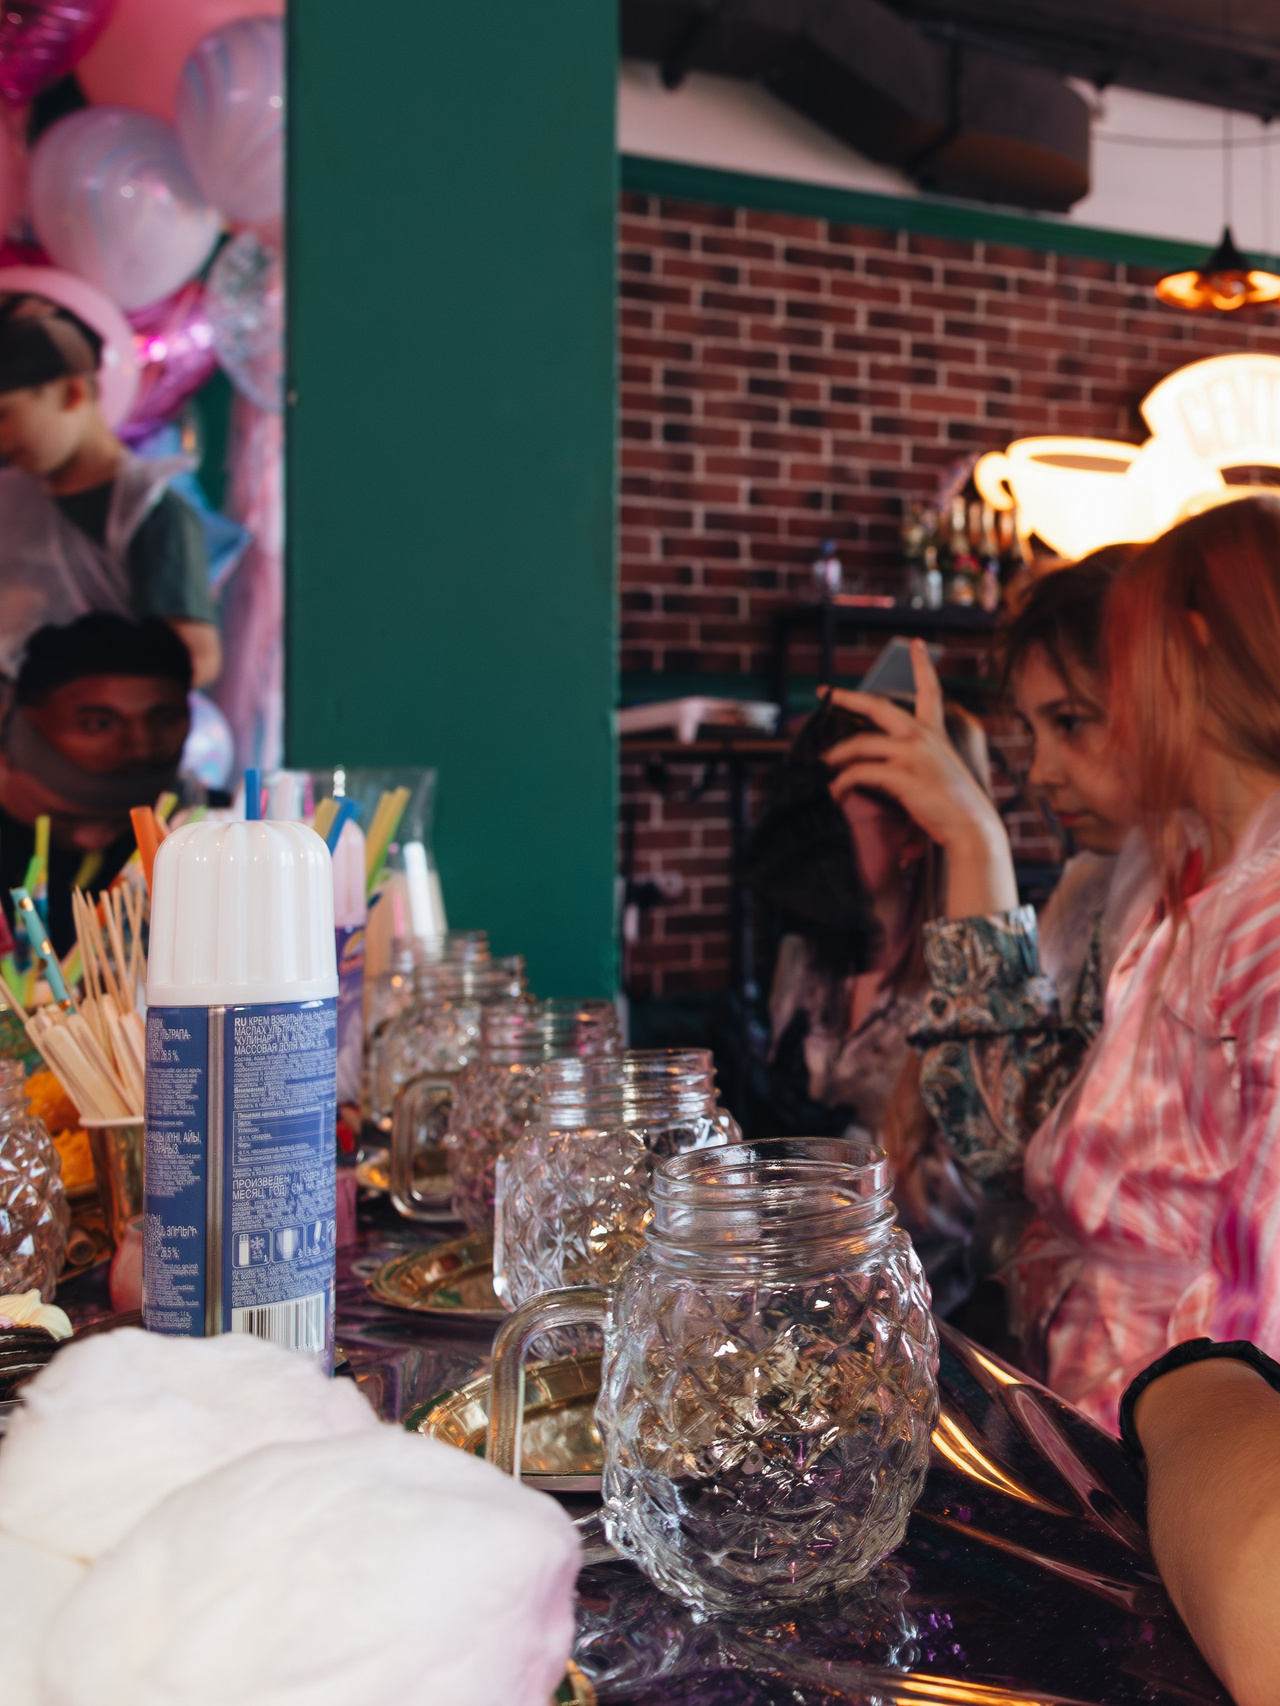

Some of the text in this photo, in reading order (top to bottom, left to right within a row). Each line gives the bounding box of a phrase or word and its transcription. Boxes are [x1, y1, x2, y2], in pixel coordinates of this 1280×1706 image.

[234, 1017, 247, 1027] RU
[248, 1015, 270, 1026] КРЕМ
[271, 1011, 304, 1024] ВЗБИТЫЙ
[234, 1026, 268, 1036] МАСЛАХ
[234, 1043, 278, 1055] МАССОВАЯ
[232, 1174, 290, 1190] ПРОИЗВЕДЕН
[232, 1188, 267, 1200] МЕСЯЦ,
